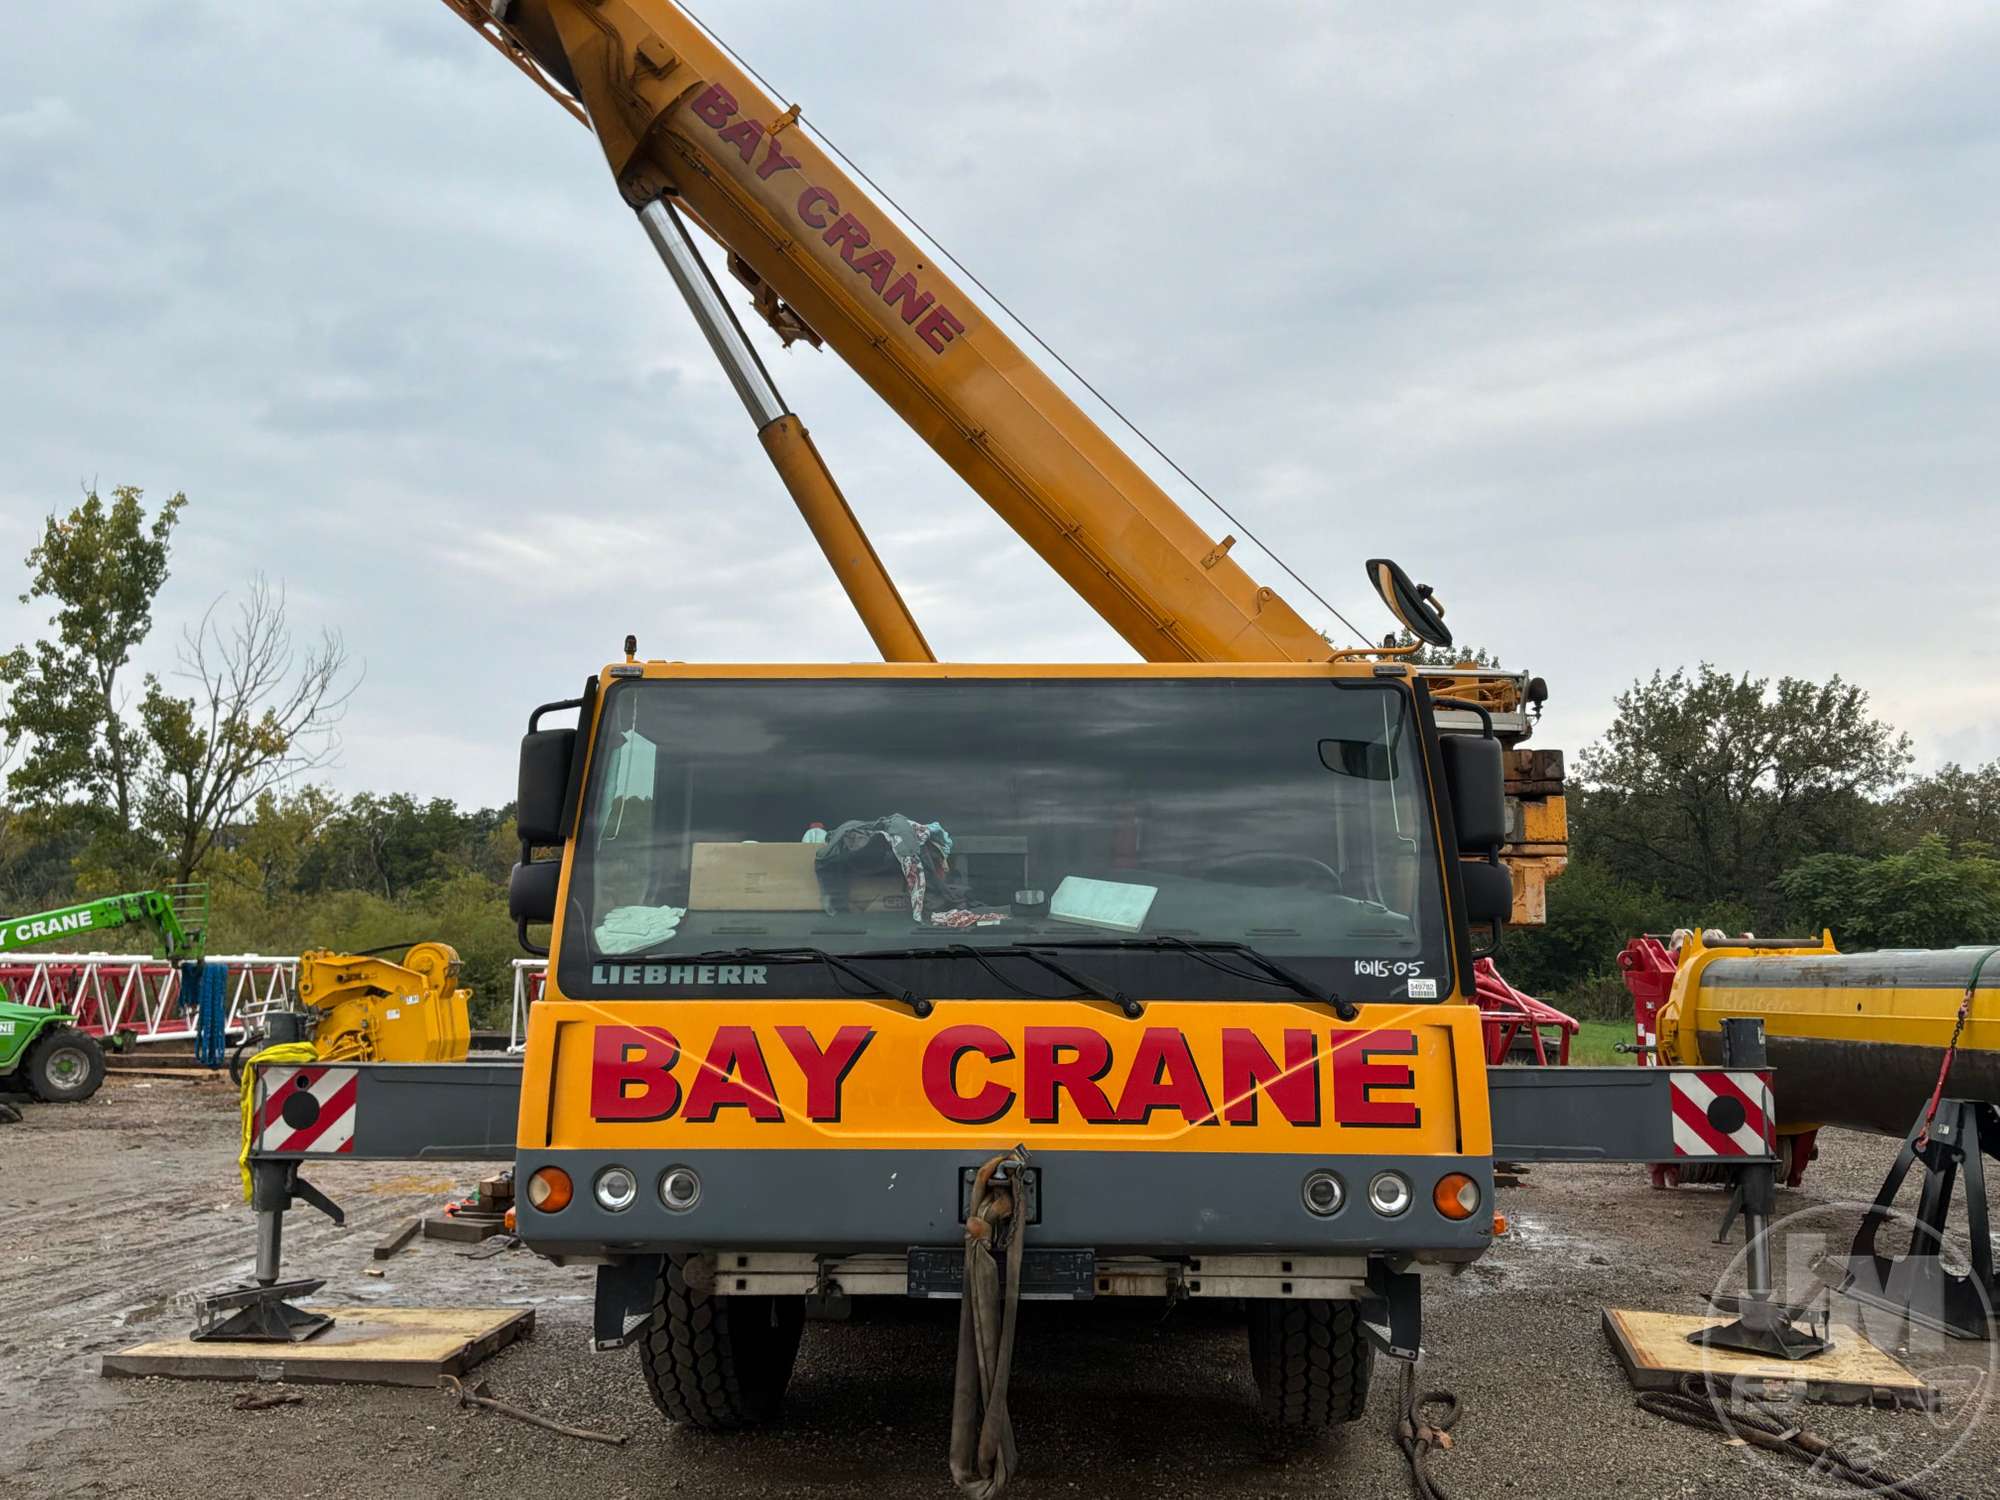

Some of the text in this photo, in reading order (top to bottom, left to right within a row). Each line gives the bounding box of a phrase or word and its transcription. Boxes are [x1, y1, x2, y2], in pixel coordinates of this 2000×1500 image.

[691, 82, 966, 355] BAY CRANE
[16, 910, 93, 941] CRANE
[592, 965, 768, 985] LIEBHERR
[590, 1024, 1421, 1128] BAY CRANE
